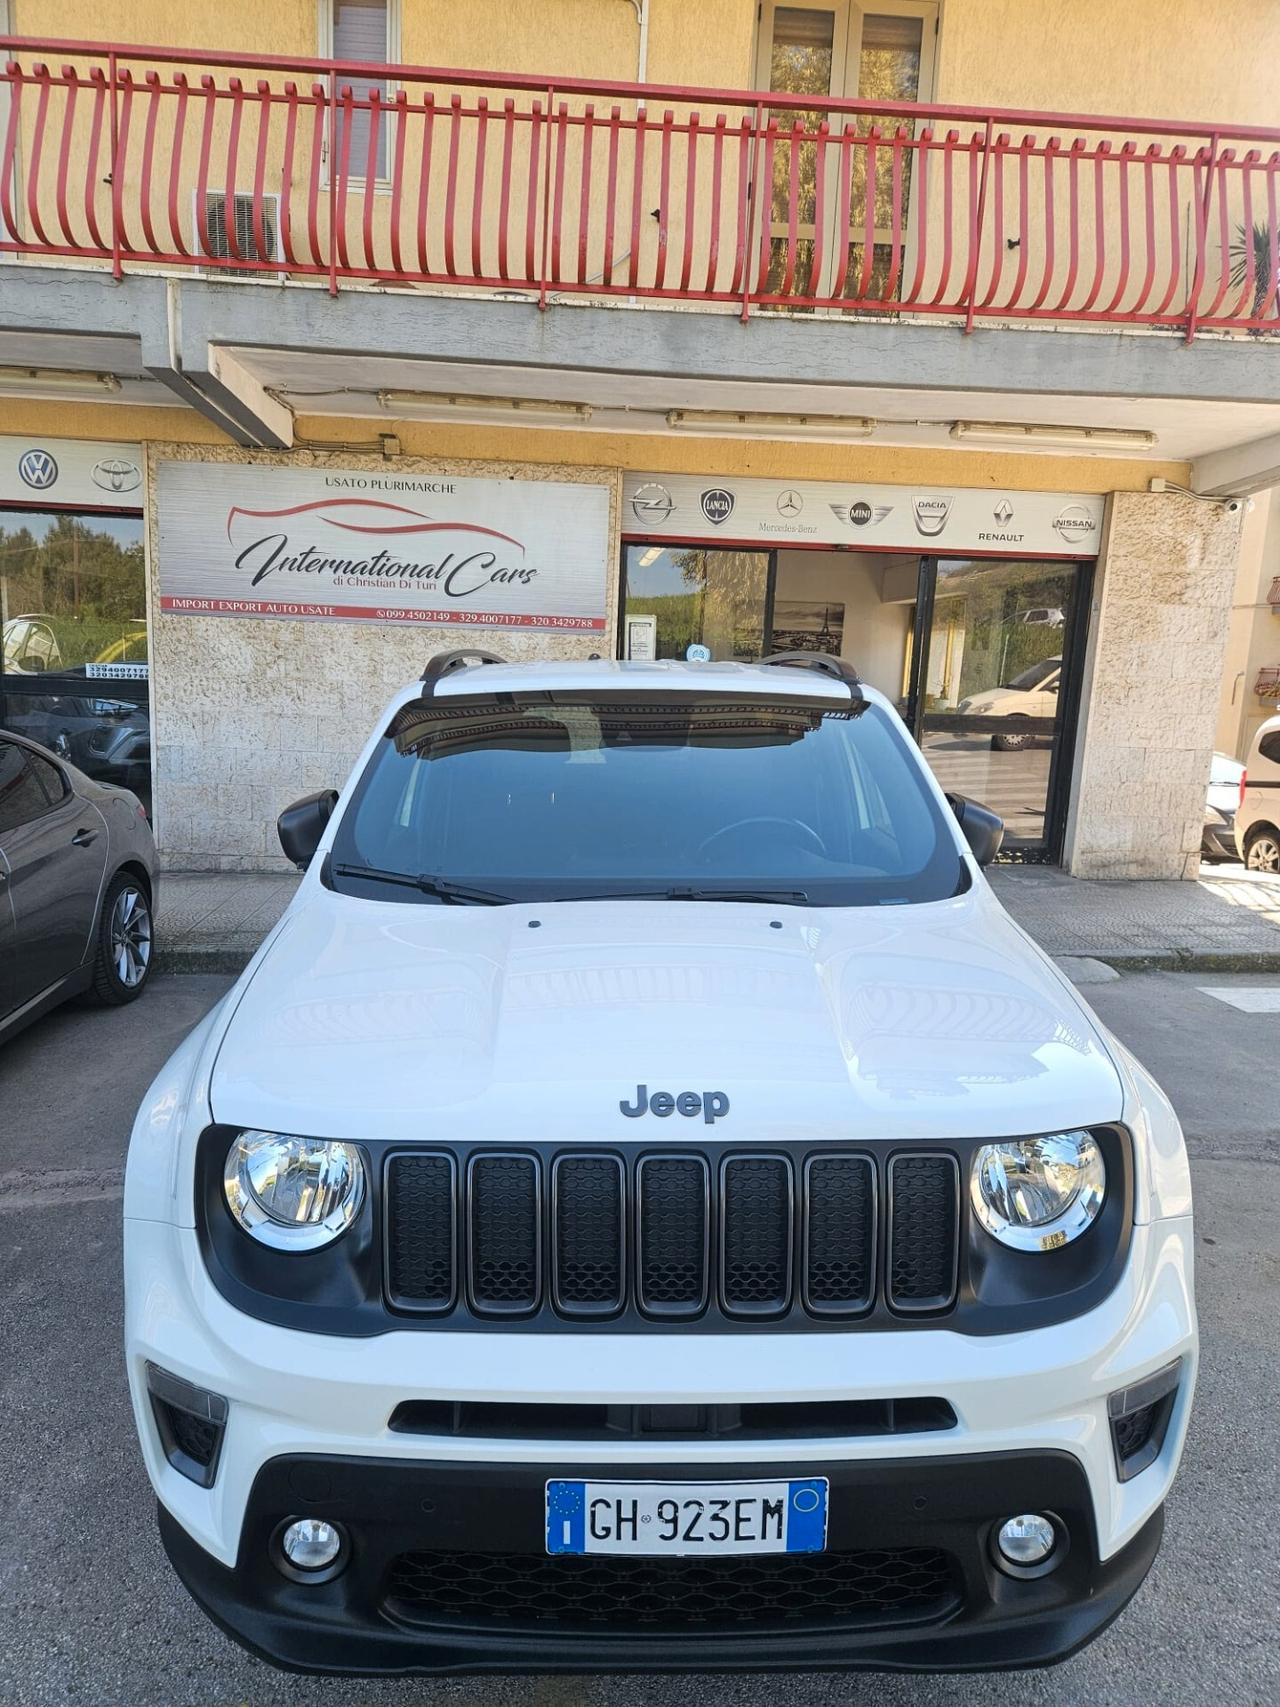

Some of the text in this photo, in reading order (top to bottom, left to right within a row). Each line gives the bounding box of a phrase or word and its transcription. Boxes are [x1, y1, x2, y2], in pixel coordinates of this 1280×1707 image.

[325, 477, 457, 494] USATO PLURIMARCHE
[706, 500, 729, 511] LANCIA
[918, 501, 947, 509] DACIA
[850, 509, 871, 519] MINI
[758, 522, 818, 534] Mercedes-Benz
[1056, 519, 1093, 528] NISSAN
[978, 532, 1025, 542] RENAULT
[234, 533, 540, 598] International Cars
[333, 576, 437, 591] di Christian Di Turi
[172, 598, 336, 616] IMPORT EXPORT AUTO USATE
[386, 608, 450, 621] 099.4502149
[459, 612, 522, 625] 329.4007177
[619, 1084, 730, 1124] Jeep
[590, 1498, 638, 1541] GH
[657, 1498, 784, 1542] 923EM
